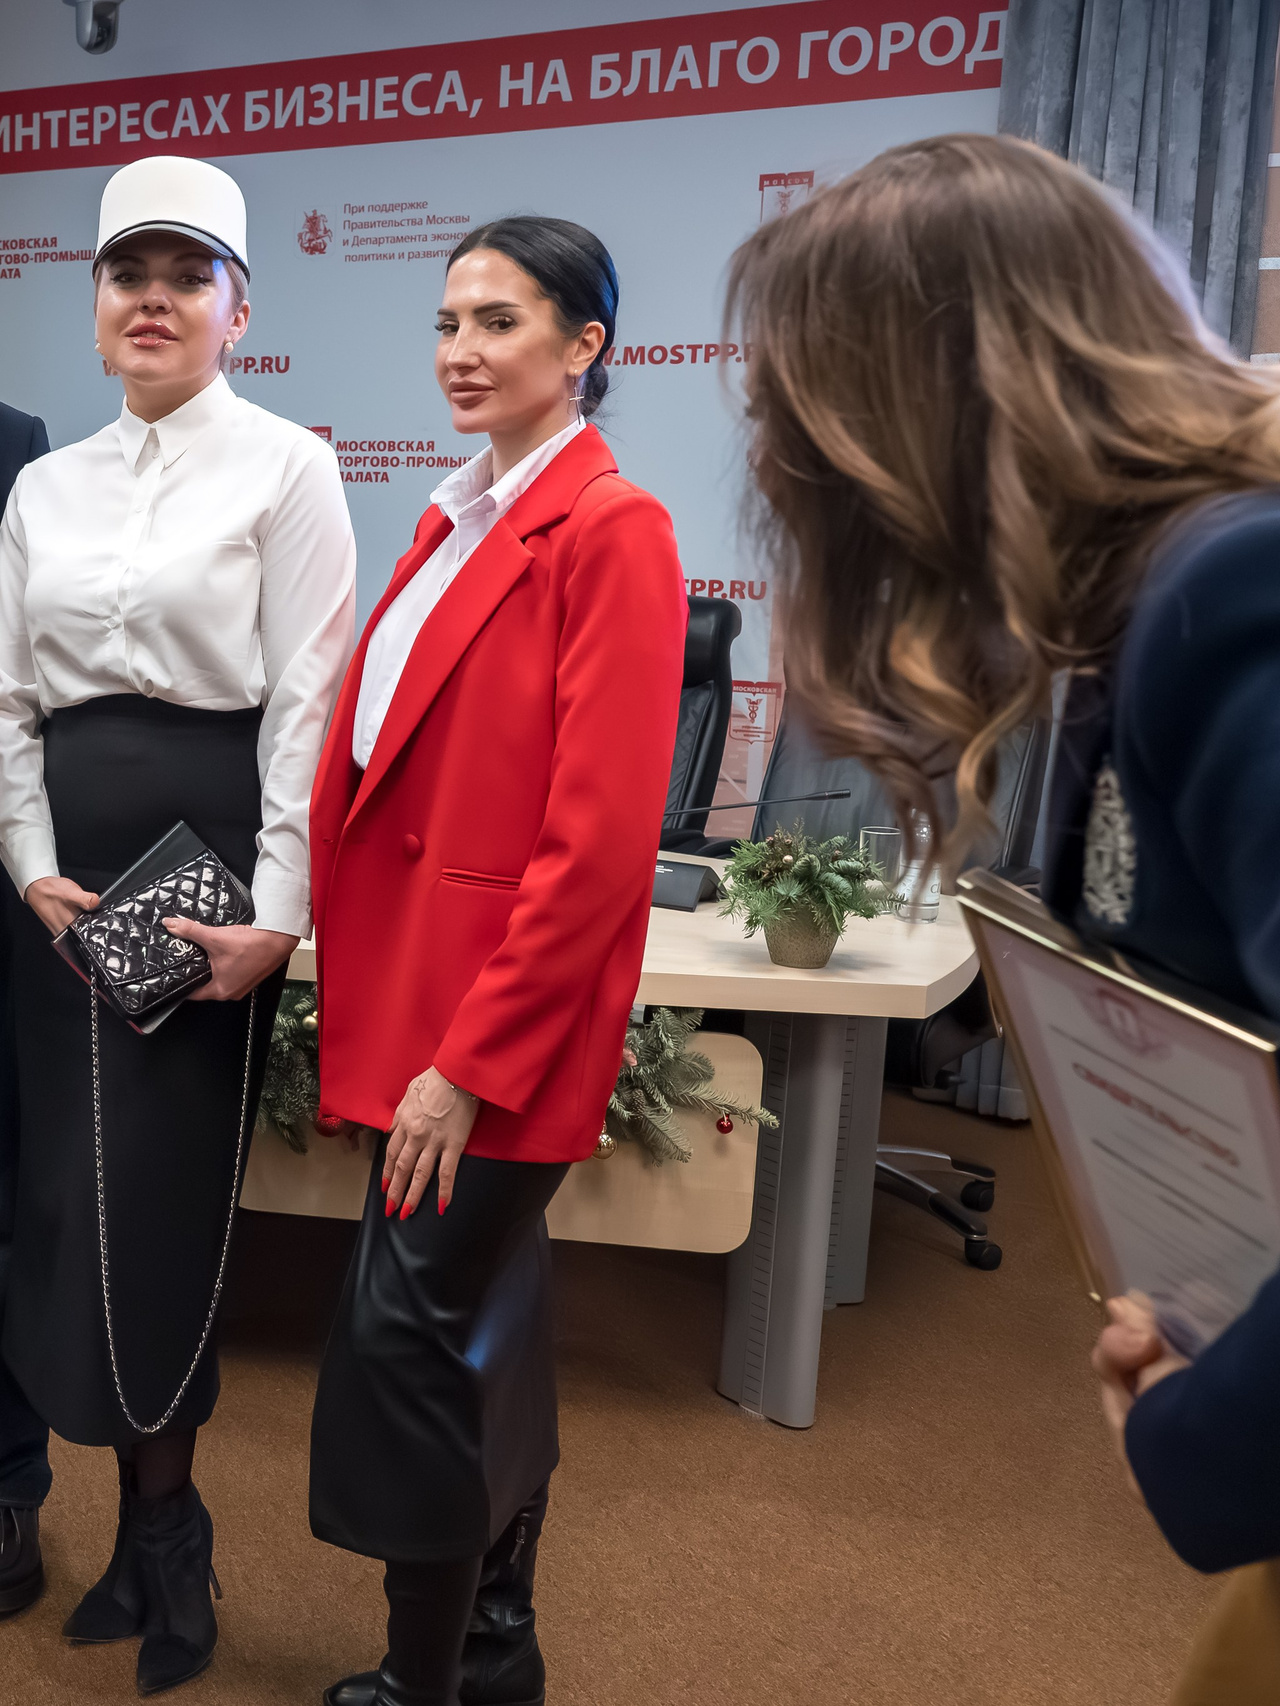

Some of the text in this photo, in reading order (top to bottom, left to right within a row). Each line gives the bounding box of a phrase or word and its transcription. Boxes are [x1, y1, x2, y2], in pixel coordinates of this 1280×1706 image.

[244, 69, 483, 132] БИЗНЕСА,
[499, 59, 573, 108] НА
[589, 36, 780, 99] БЛАГО
[343, 200, 428, 216] При поддержке
[343, 214, 470, 232] Правительства Москвы
[342, 238, 349, 246] и
[351, 233, 428, 248] Департамента
[344, 251, 395, 263] политики
[398, 251, 405, 259] и
[336, 440, 435, 452] МОСКОВСКАЯ
